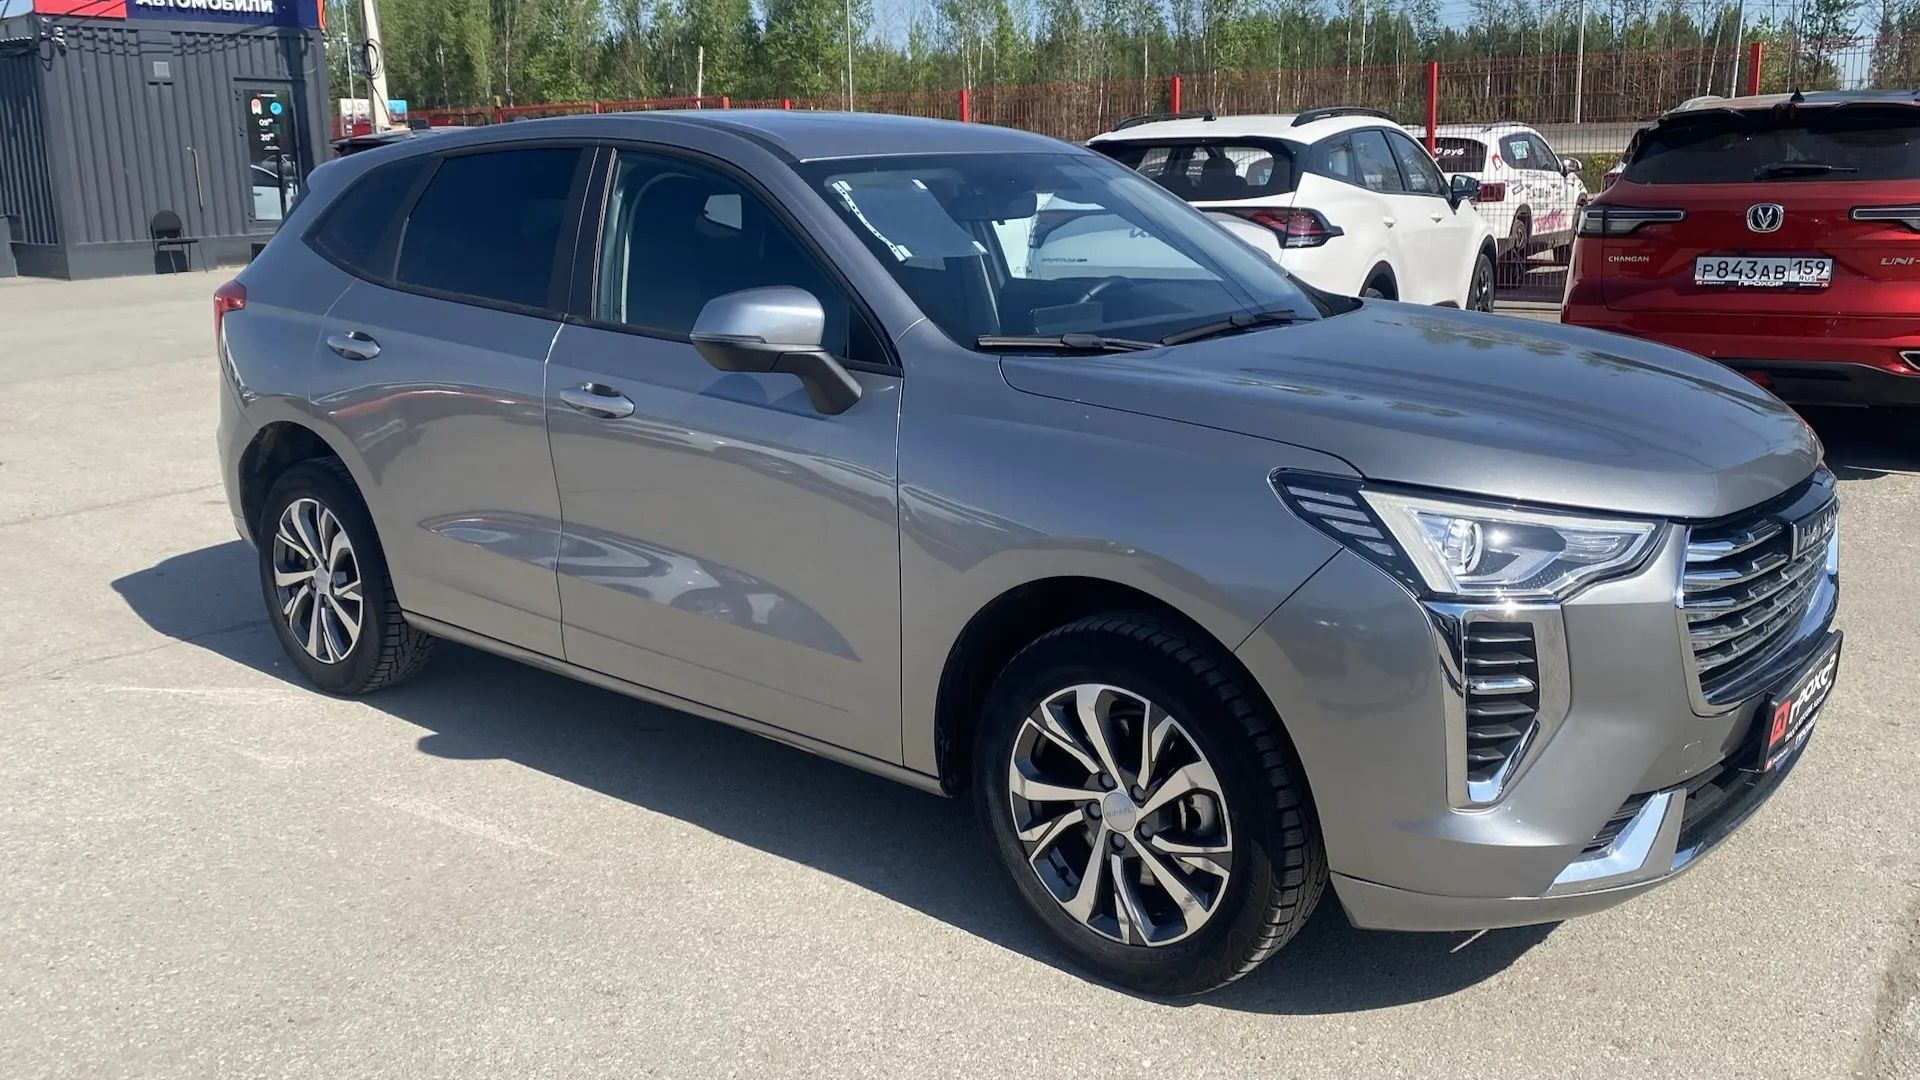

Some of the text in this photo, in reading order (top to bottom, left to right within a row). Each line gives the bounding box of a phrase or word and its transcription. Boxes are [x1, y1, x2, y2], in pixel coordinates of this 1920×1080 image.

[1608, 255, 1650, 263] CHANGAN
[1793, 260, 1827, 276] 159
[1788, 652, 1837, 725] ПРОХОР
